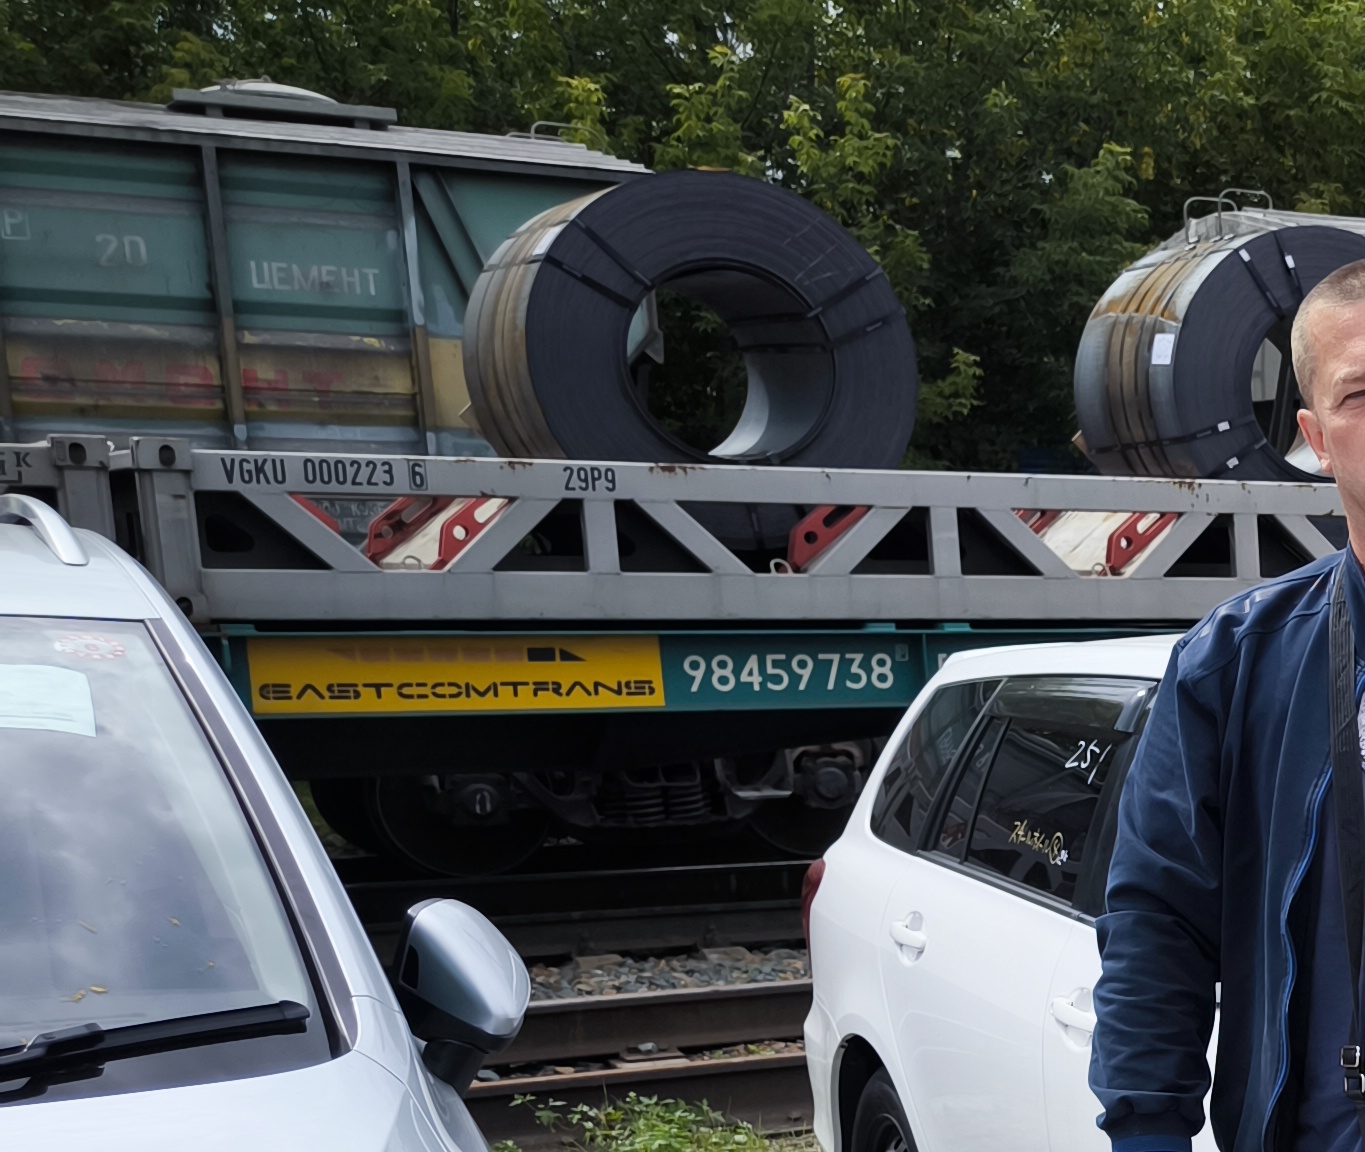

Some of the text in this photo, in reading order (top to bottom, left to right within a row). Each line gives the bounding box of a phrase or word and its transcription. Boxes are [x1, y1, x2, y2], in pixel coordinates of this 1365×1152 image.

[249, 260, 379, 297] ЦЕМЕНТ
[220, 456, 426, 489] VGKU 000223 6
[562, 465, 617, 493] 29P9
[682, 651, 895, 694] 98459738
[258, 678, 656, 702] EASTCOMTRANS
